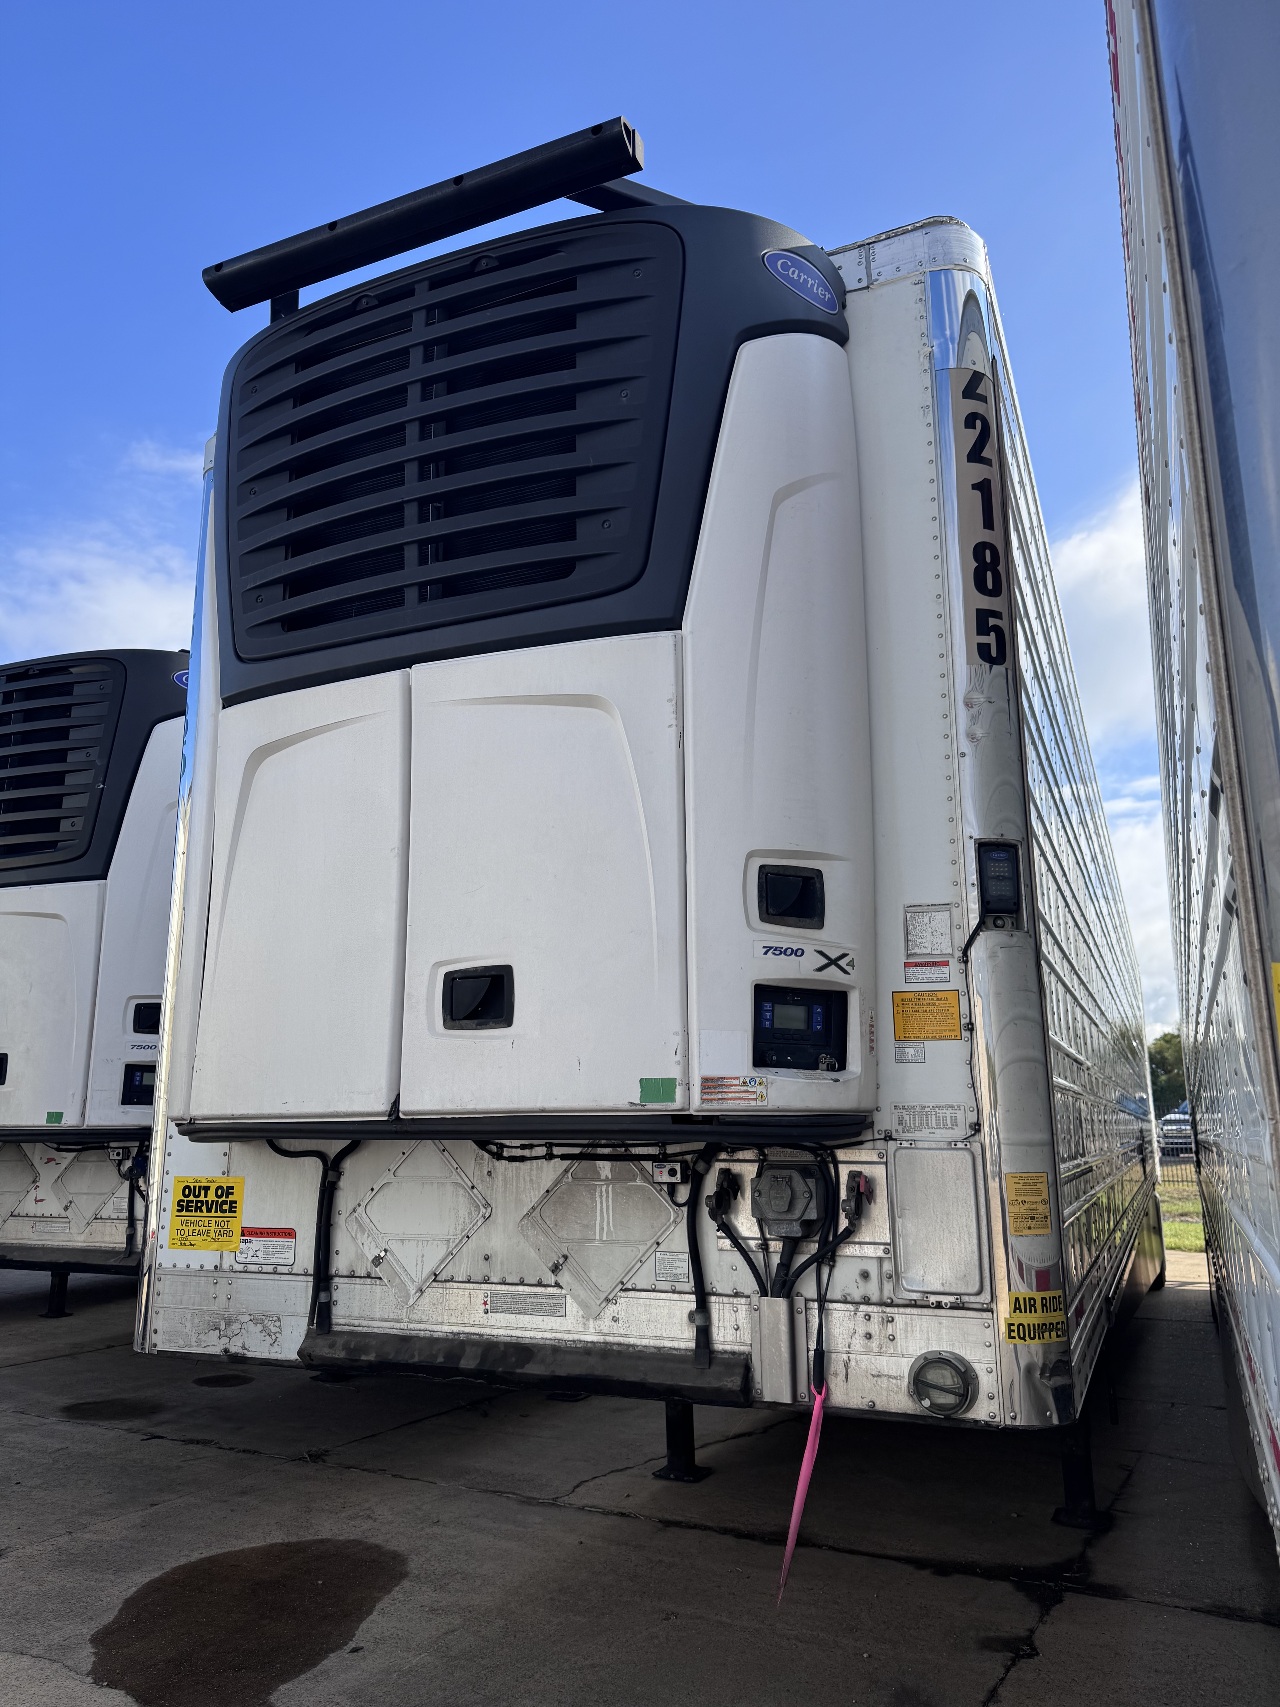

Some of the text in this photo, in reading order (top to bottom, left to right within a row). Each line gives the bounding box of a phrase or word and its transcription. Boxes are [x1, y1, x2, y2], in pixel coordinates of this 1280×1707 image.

[777, 259, 831, 302] Carrier
[762, 945, 805, 958] 7500
[181, 1184, 235, 1199] OUT OF
[176, 1199, 238, 1214] SERVICE
[180, 1219, 231, 1228] VEHICLE NOT
[175, 1228, 234, 1238] TO LEAVE YARD
[1013, 1295, 1063, 1314] AIR RIDE
[1007, 1320, 1067, 1342] EQUIPPED
